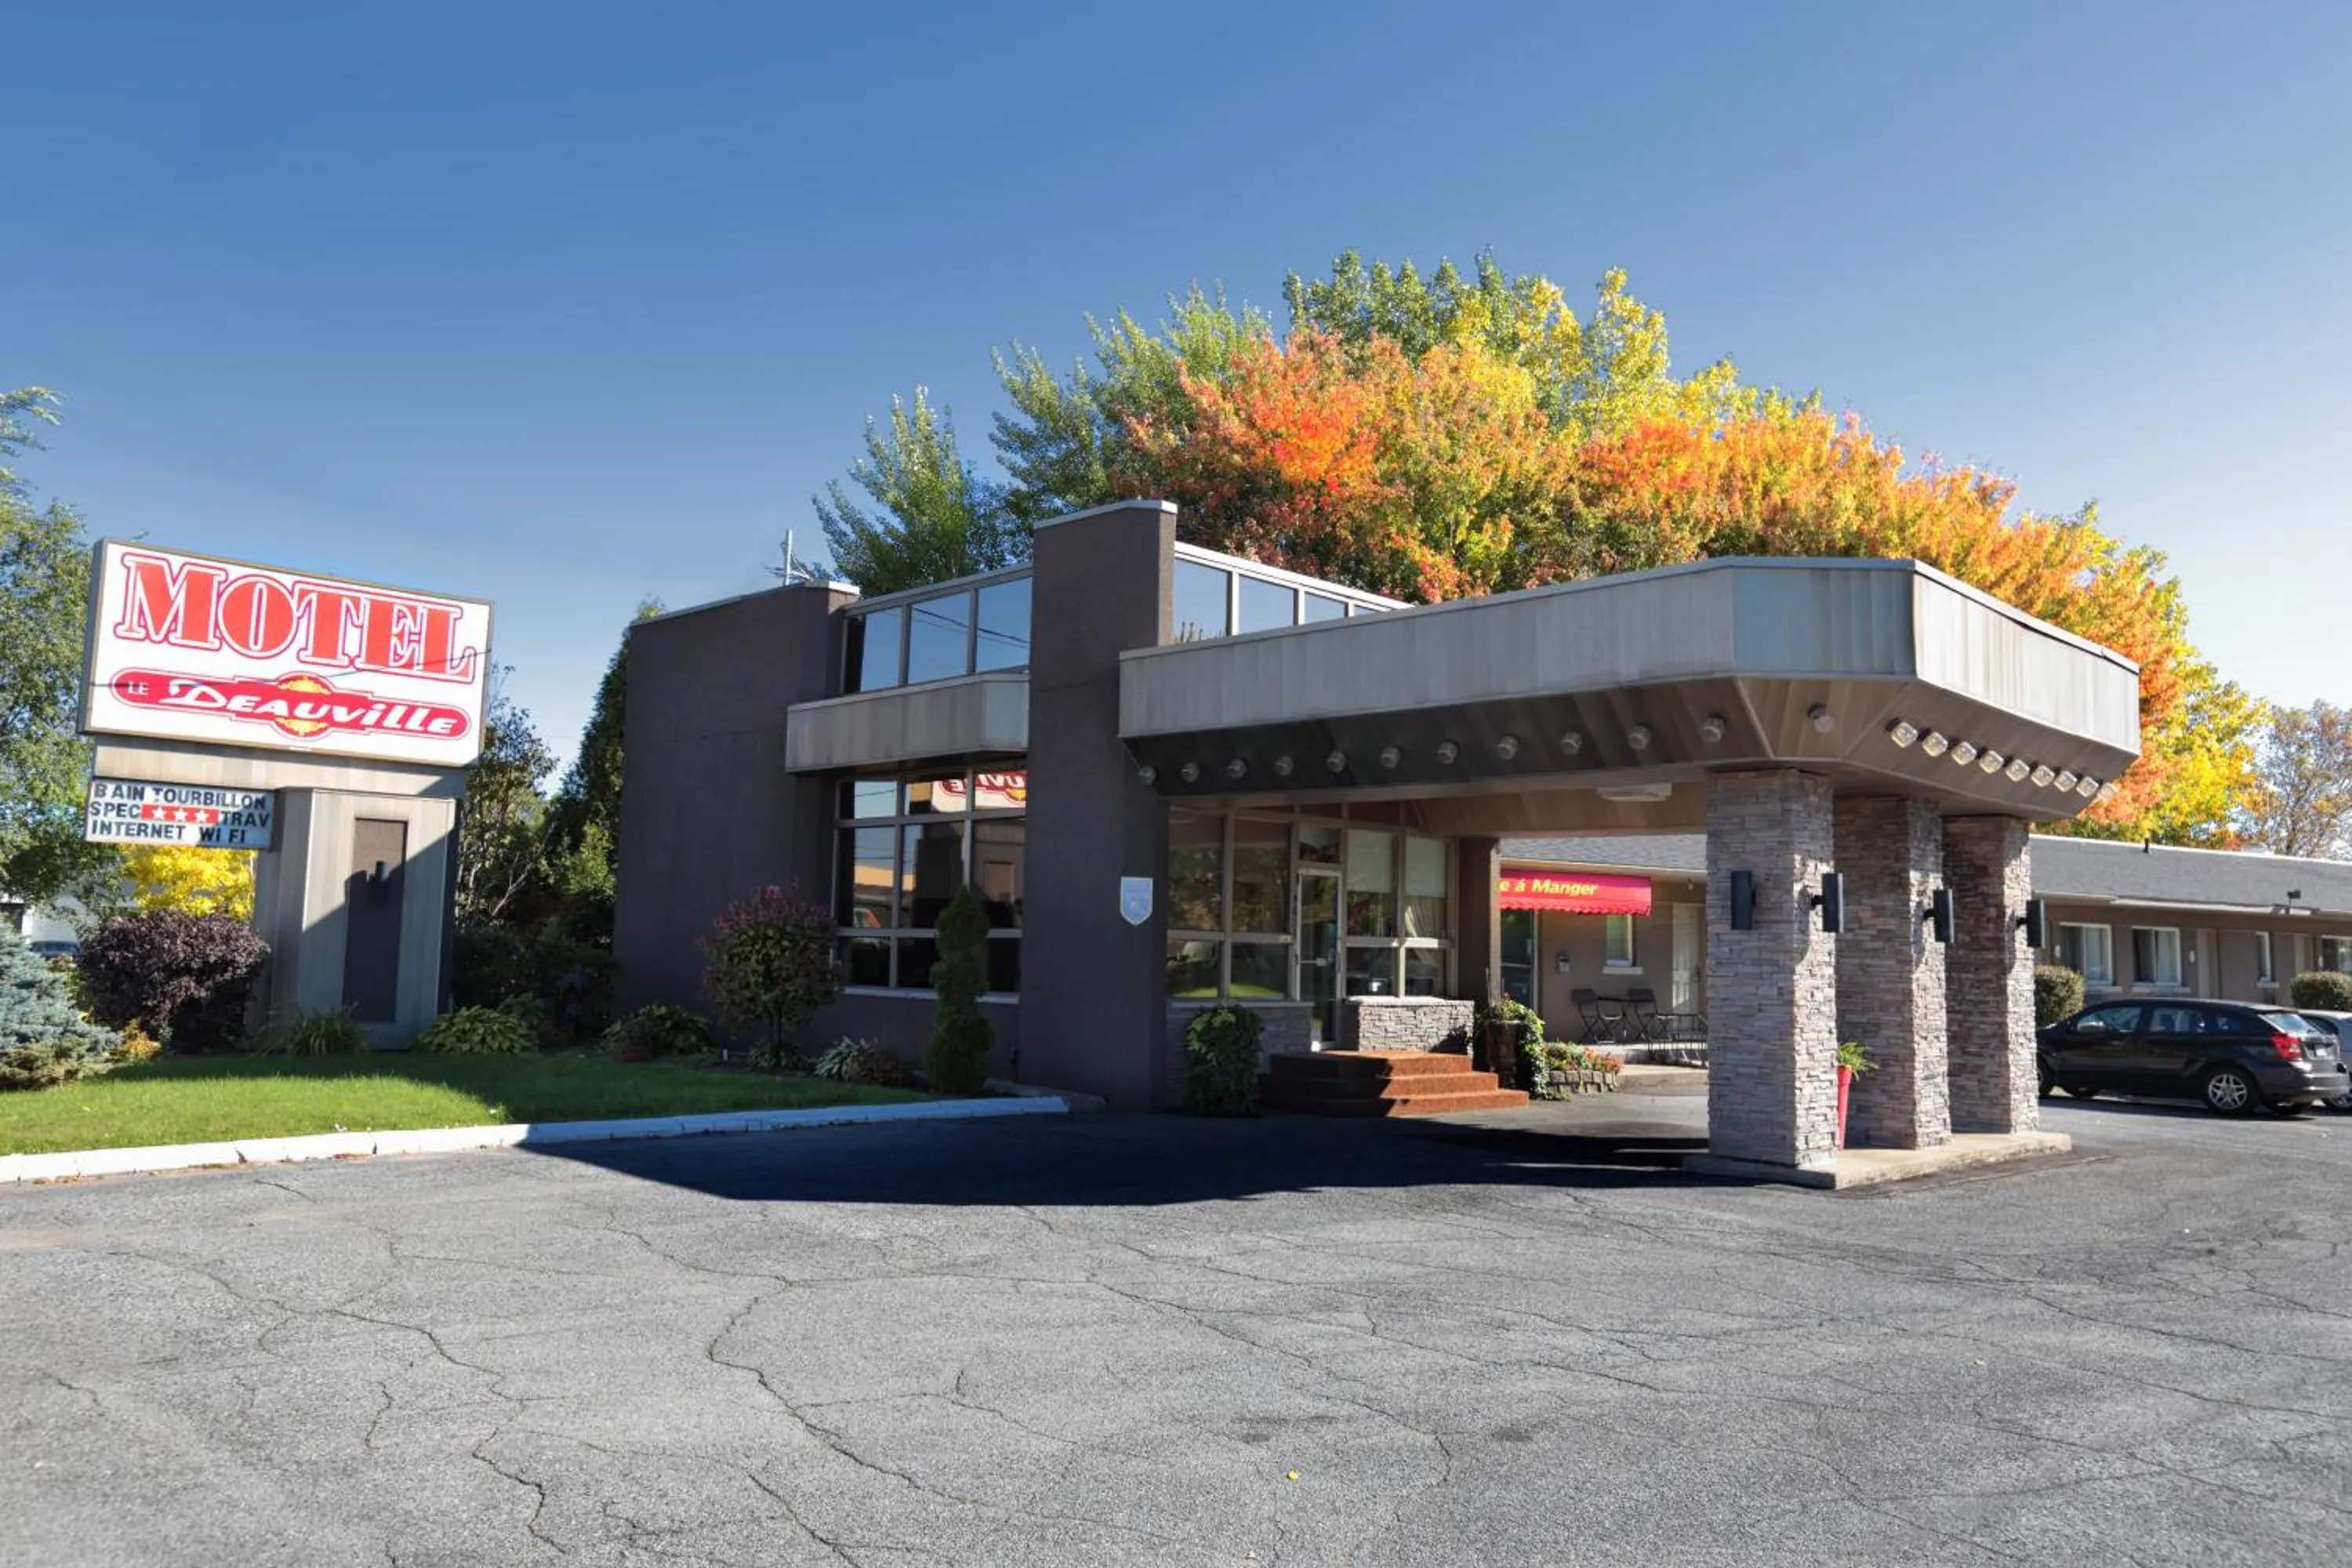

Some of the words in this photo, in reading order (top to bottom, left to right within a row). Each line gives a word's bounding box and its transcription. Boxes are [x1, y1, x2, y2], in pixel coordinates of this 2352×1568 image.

[114, 553, 475, 683] MOTEL
[128, 680, 149, 696] LE
[152, 787, 266, 810] TOURBILLON
[92, 820, 186, 840] INTERNET
[199, 826, 221, 843] WI
[228, 828, 246, 844] FI
[1532, 879, 1598, 896] Manger
